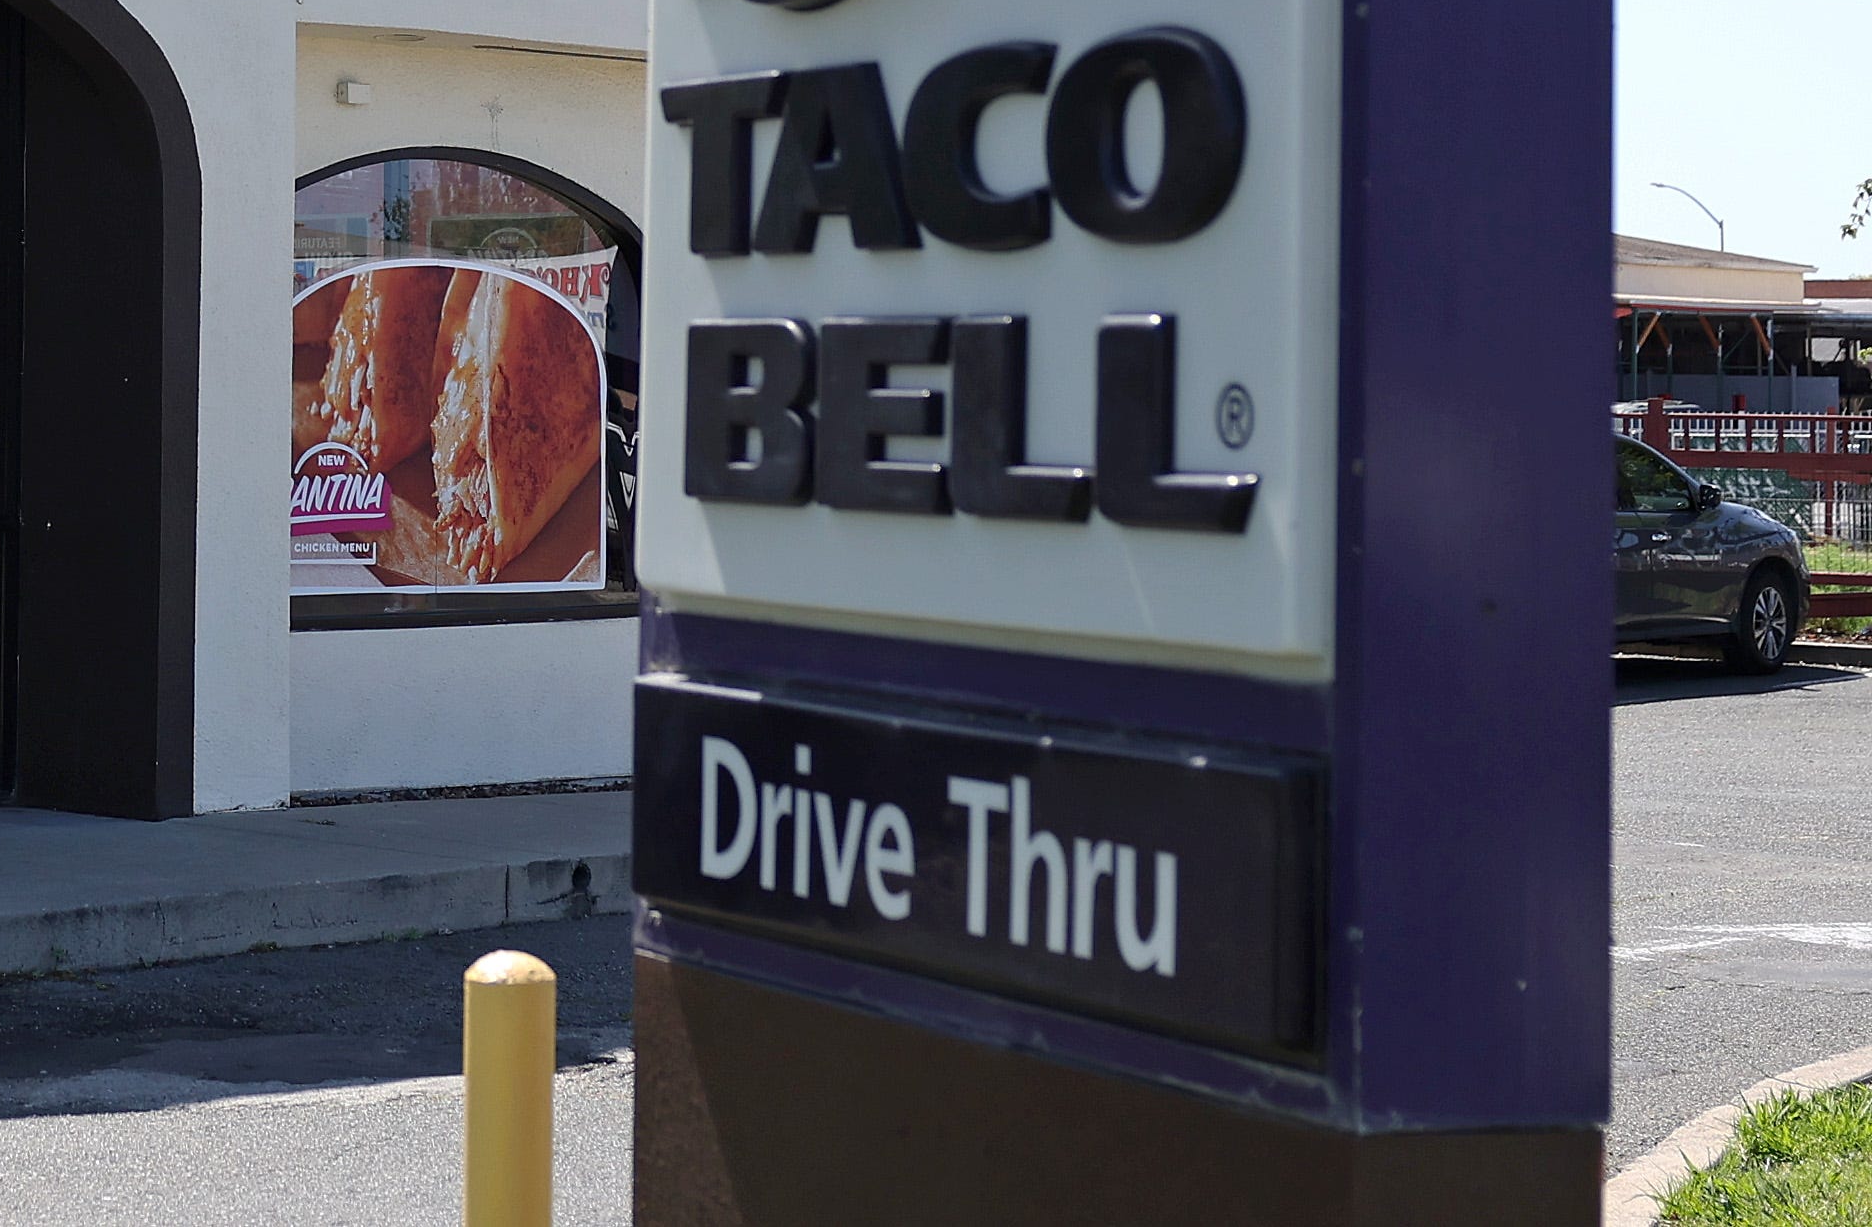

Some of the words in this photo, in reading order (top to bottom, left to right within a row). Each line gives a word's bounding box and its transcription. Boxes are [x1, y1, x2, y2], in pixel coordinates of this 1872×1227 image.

[661, 24, 1248, 255] TACO
[318, 455, 345, 466] NEW
[684, 313, 1260, 534] BELL
[289, 472, 385, 512] ANTINA
[293, 542, 339, 553] CHICKEN
[340, 542, 370, 553] MENU
[701, 735, 916, 921] Drive
[947, 775, 1177, 978] Thru
